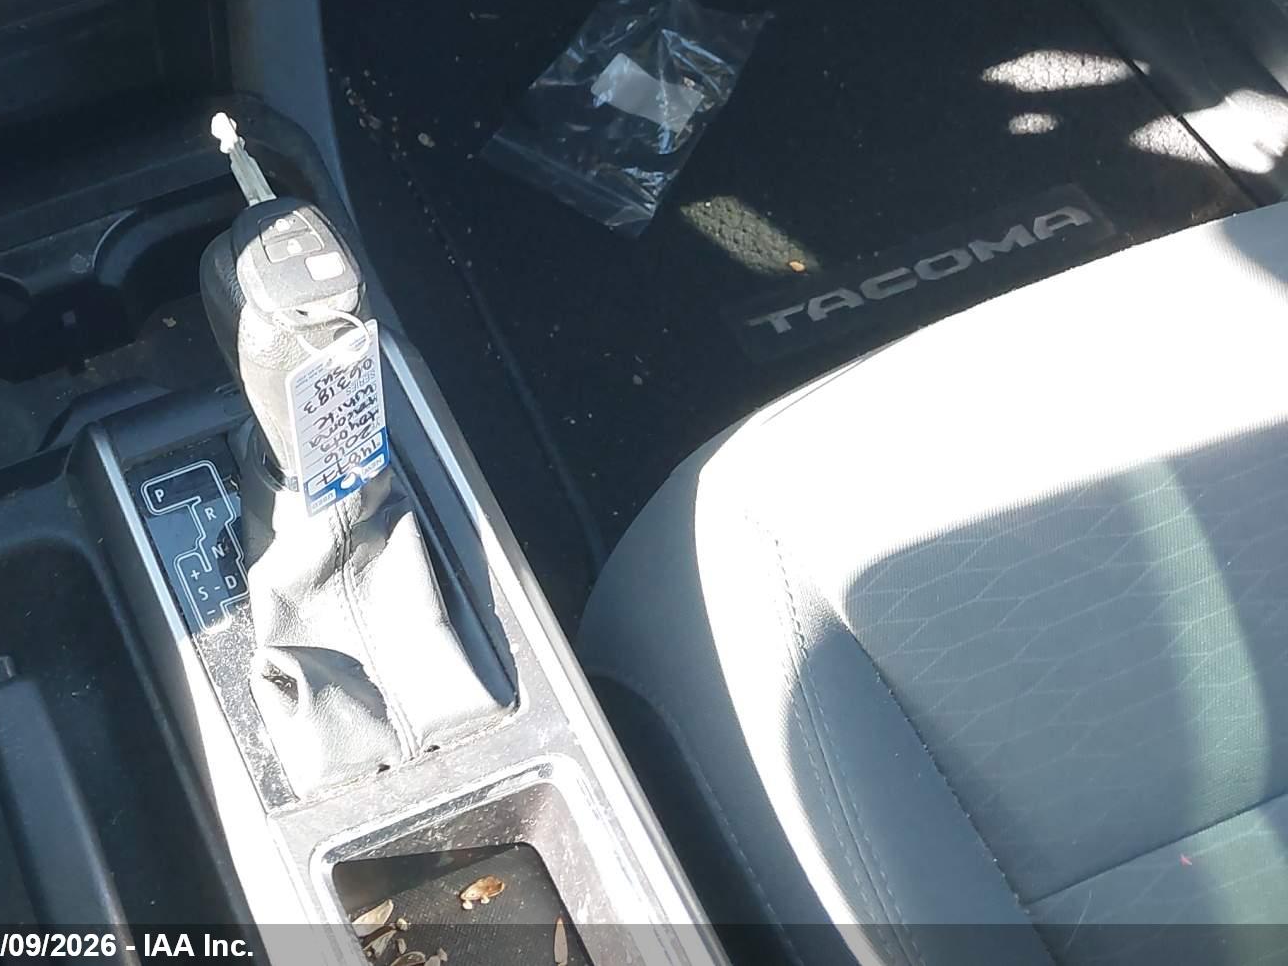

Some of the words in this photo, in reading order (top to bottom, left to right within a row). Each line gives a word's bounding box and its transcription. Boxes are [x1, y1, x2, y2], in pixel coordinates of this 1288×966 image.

[745, 206, 1093, 334] TACOMA
[154, 489, 165, 503] P
[204, 507, 217, 521] R
[211, 543, 226, 559] N
[197, 586, 209, 601] S
[224, 575, 238, 590] D
